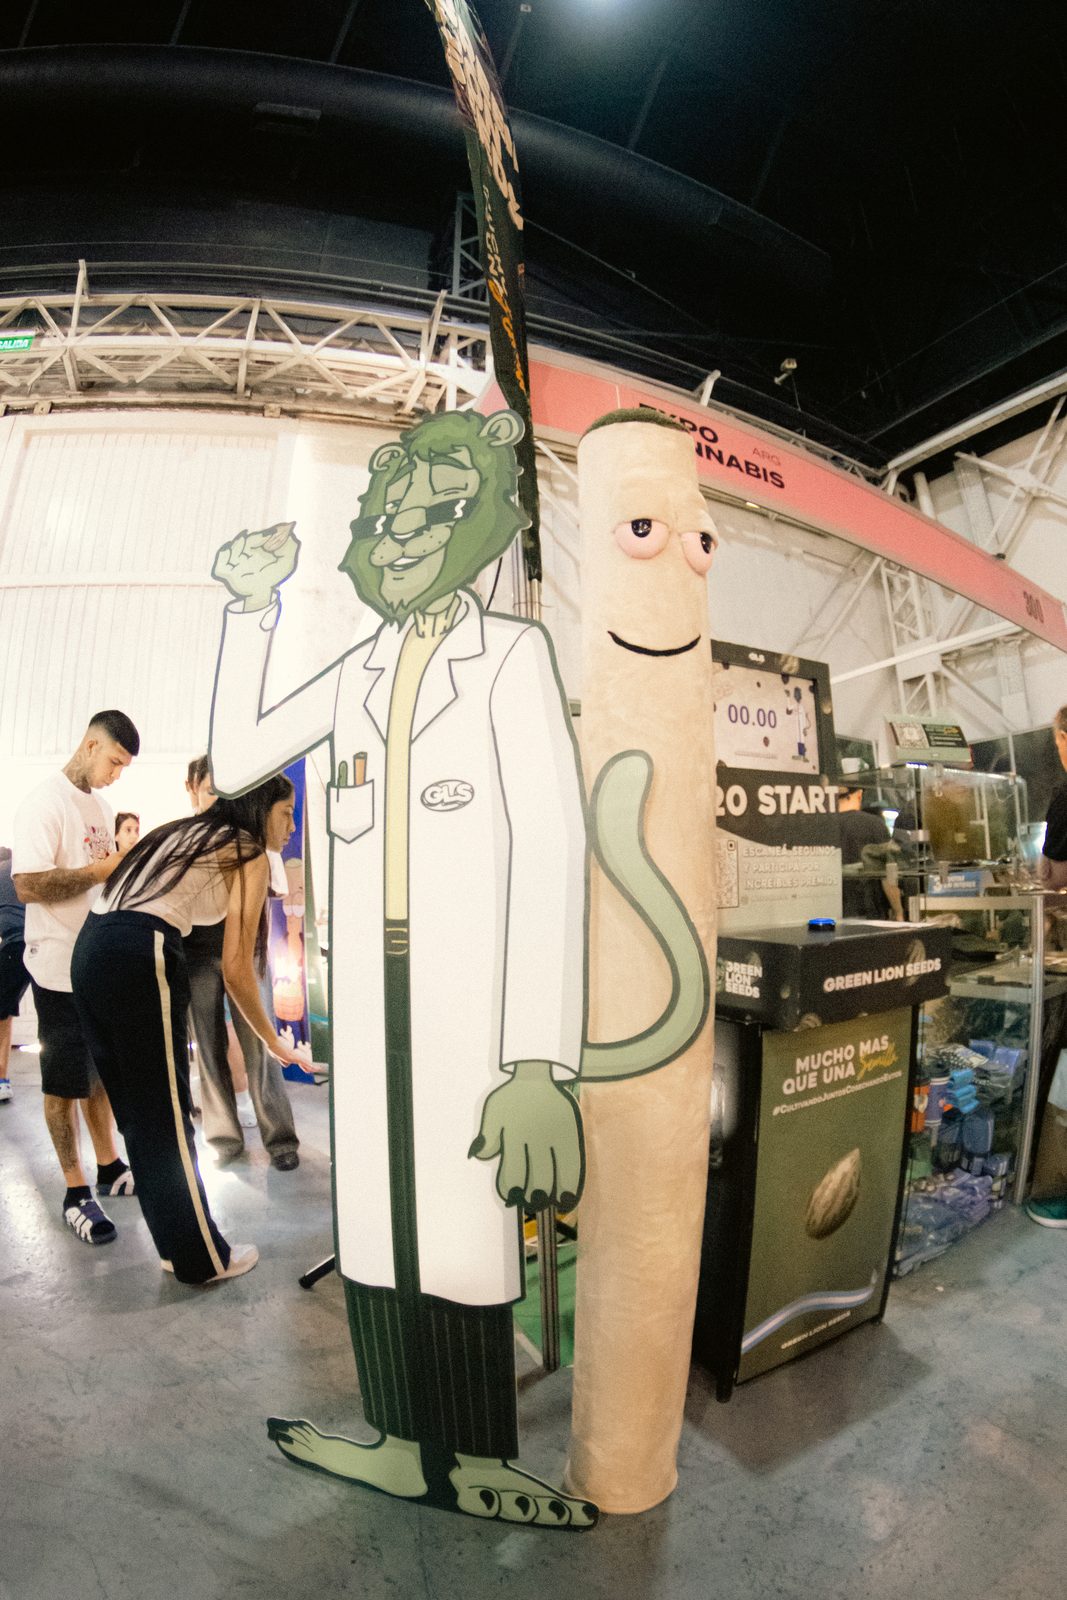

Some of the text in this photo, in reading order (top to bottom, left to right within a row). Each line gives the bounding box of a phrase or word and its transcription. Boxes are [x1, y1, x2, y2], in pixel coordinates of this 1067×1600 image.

[752, 447, 781, 466] ARG
[728, 703, 777, 729] 00.00
[757, 785, 839, 816] START
[725, 971, 752, 986] LION
[823, 957, 942, 992] GREEN LION SEEDS
[725, 982, 761, 999] SEEDS
[795, 1035, 889, 1074] MUCHO MAS
[782, 1071, 818, 1095] QUE
[823, 1061, 856, 1084] UNA
